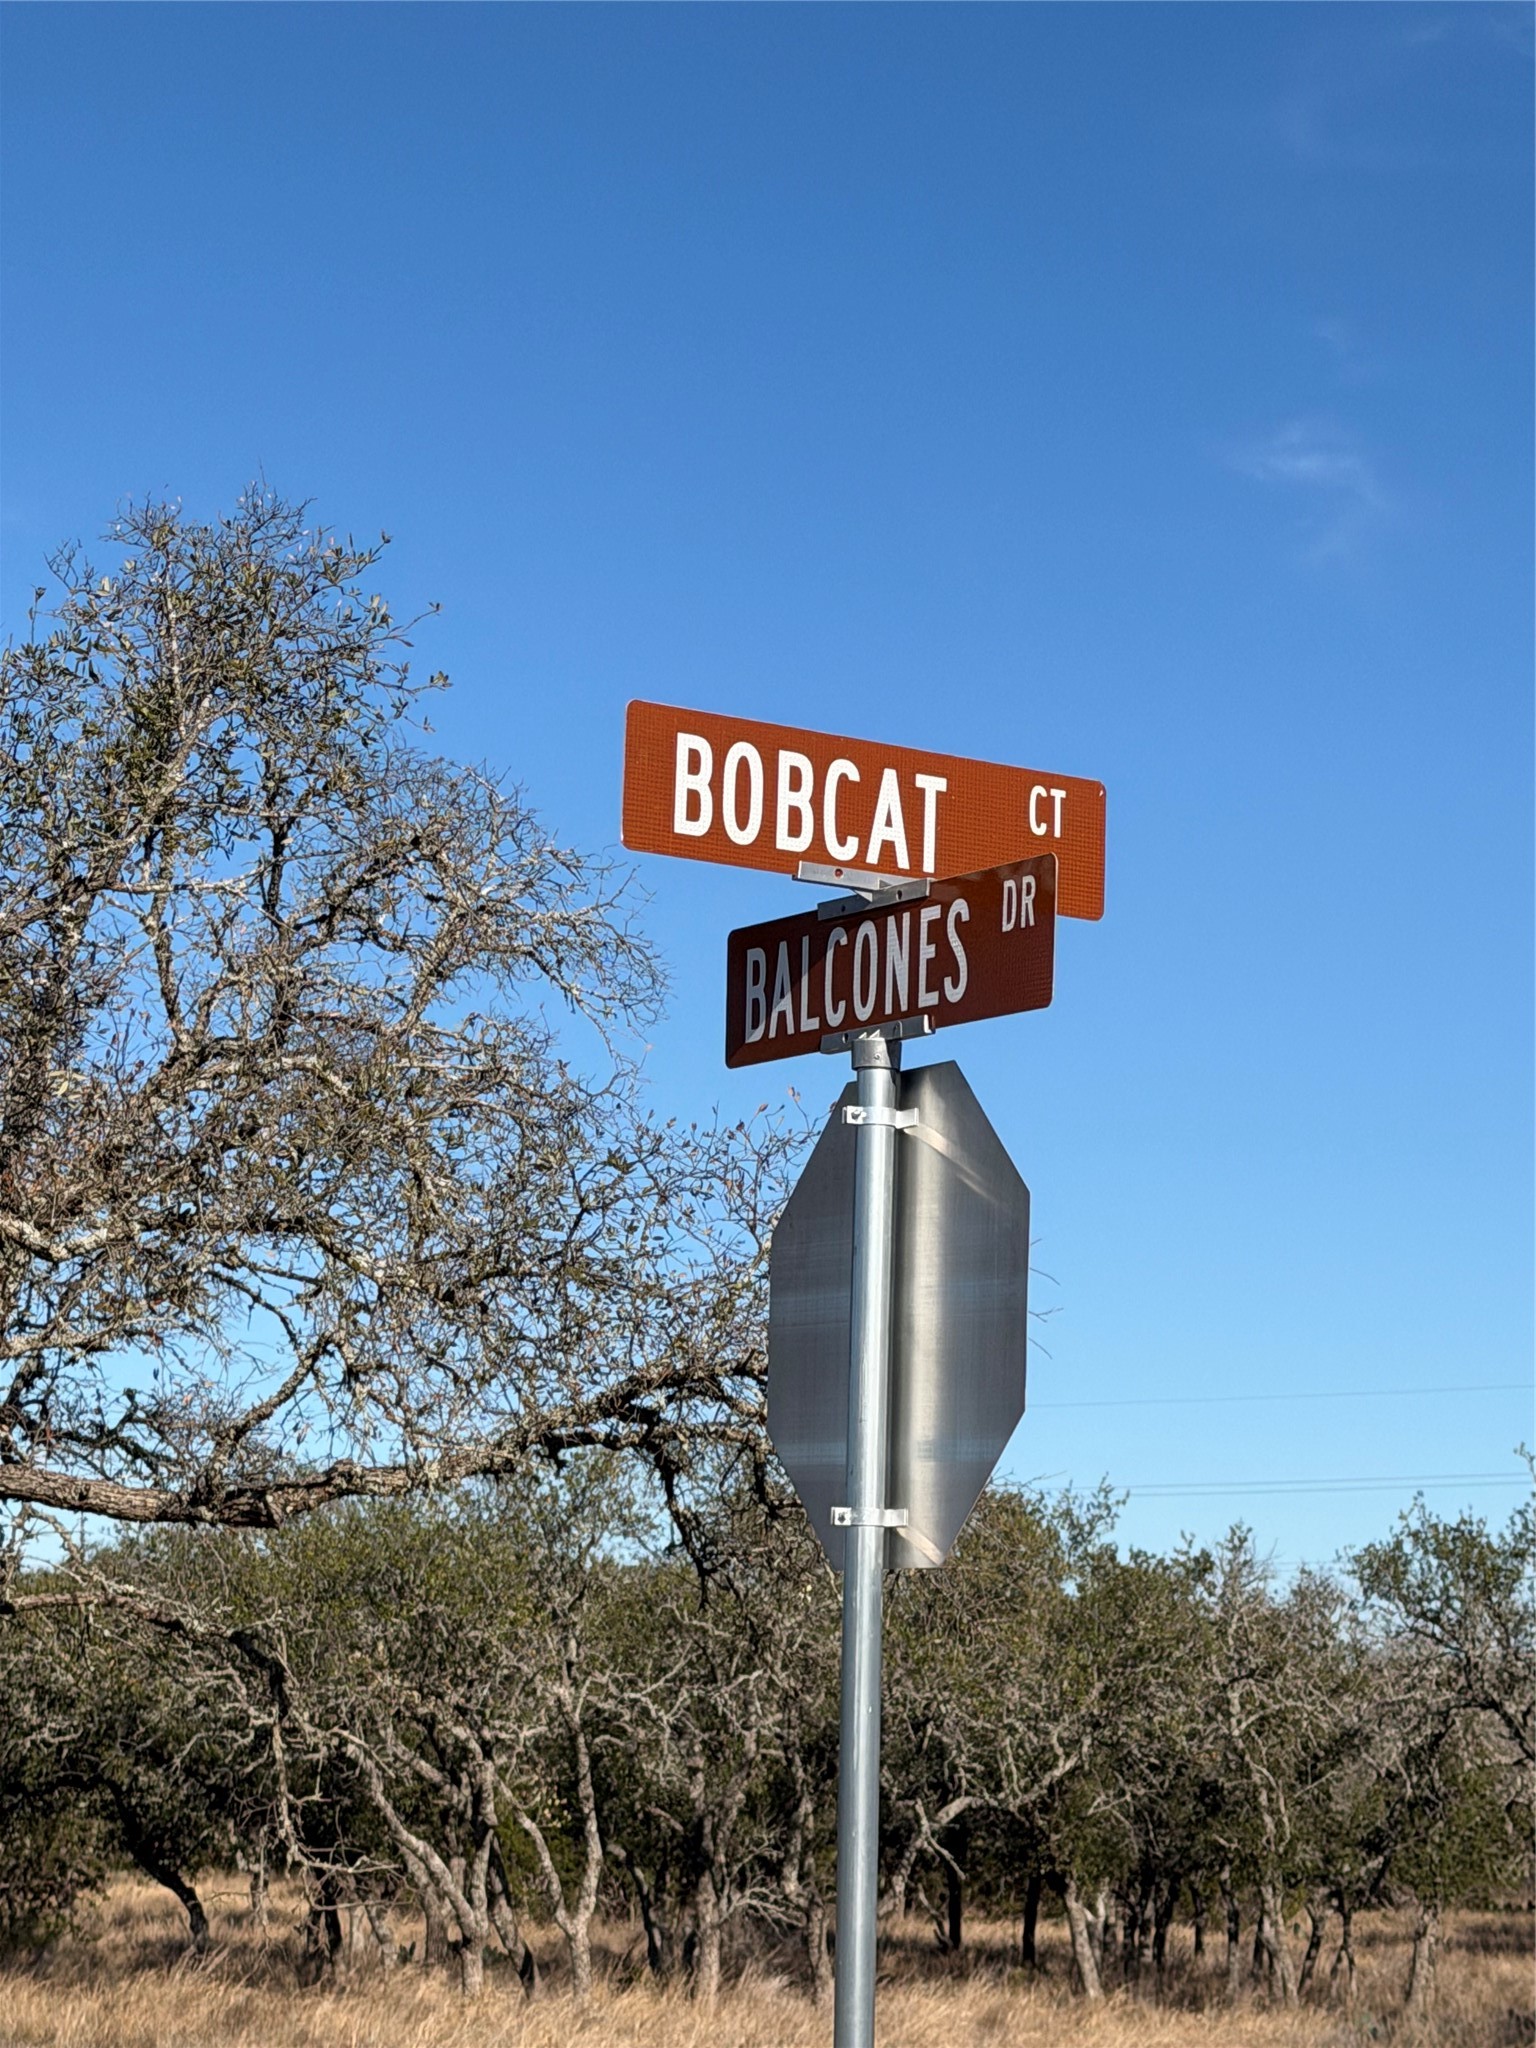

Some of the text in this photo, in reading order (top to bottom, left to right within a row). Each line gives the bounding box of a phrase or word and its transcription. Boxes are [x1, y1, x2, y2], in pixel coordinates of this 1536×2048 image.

[674, 732, 1067, 873] BOBCAT CT
[745, 874, 1037, 1044] BALCONES DR
